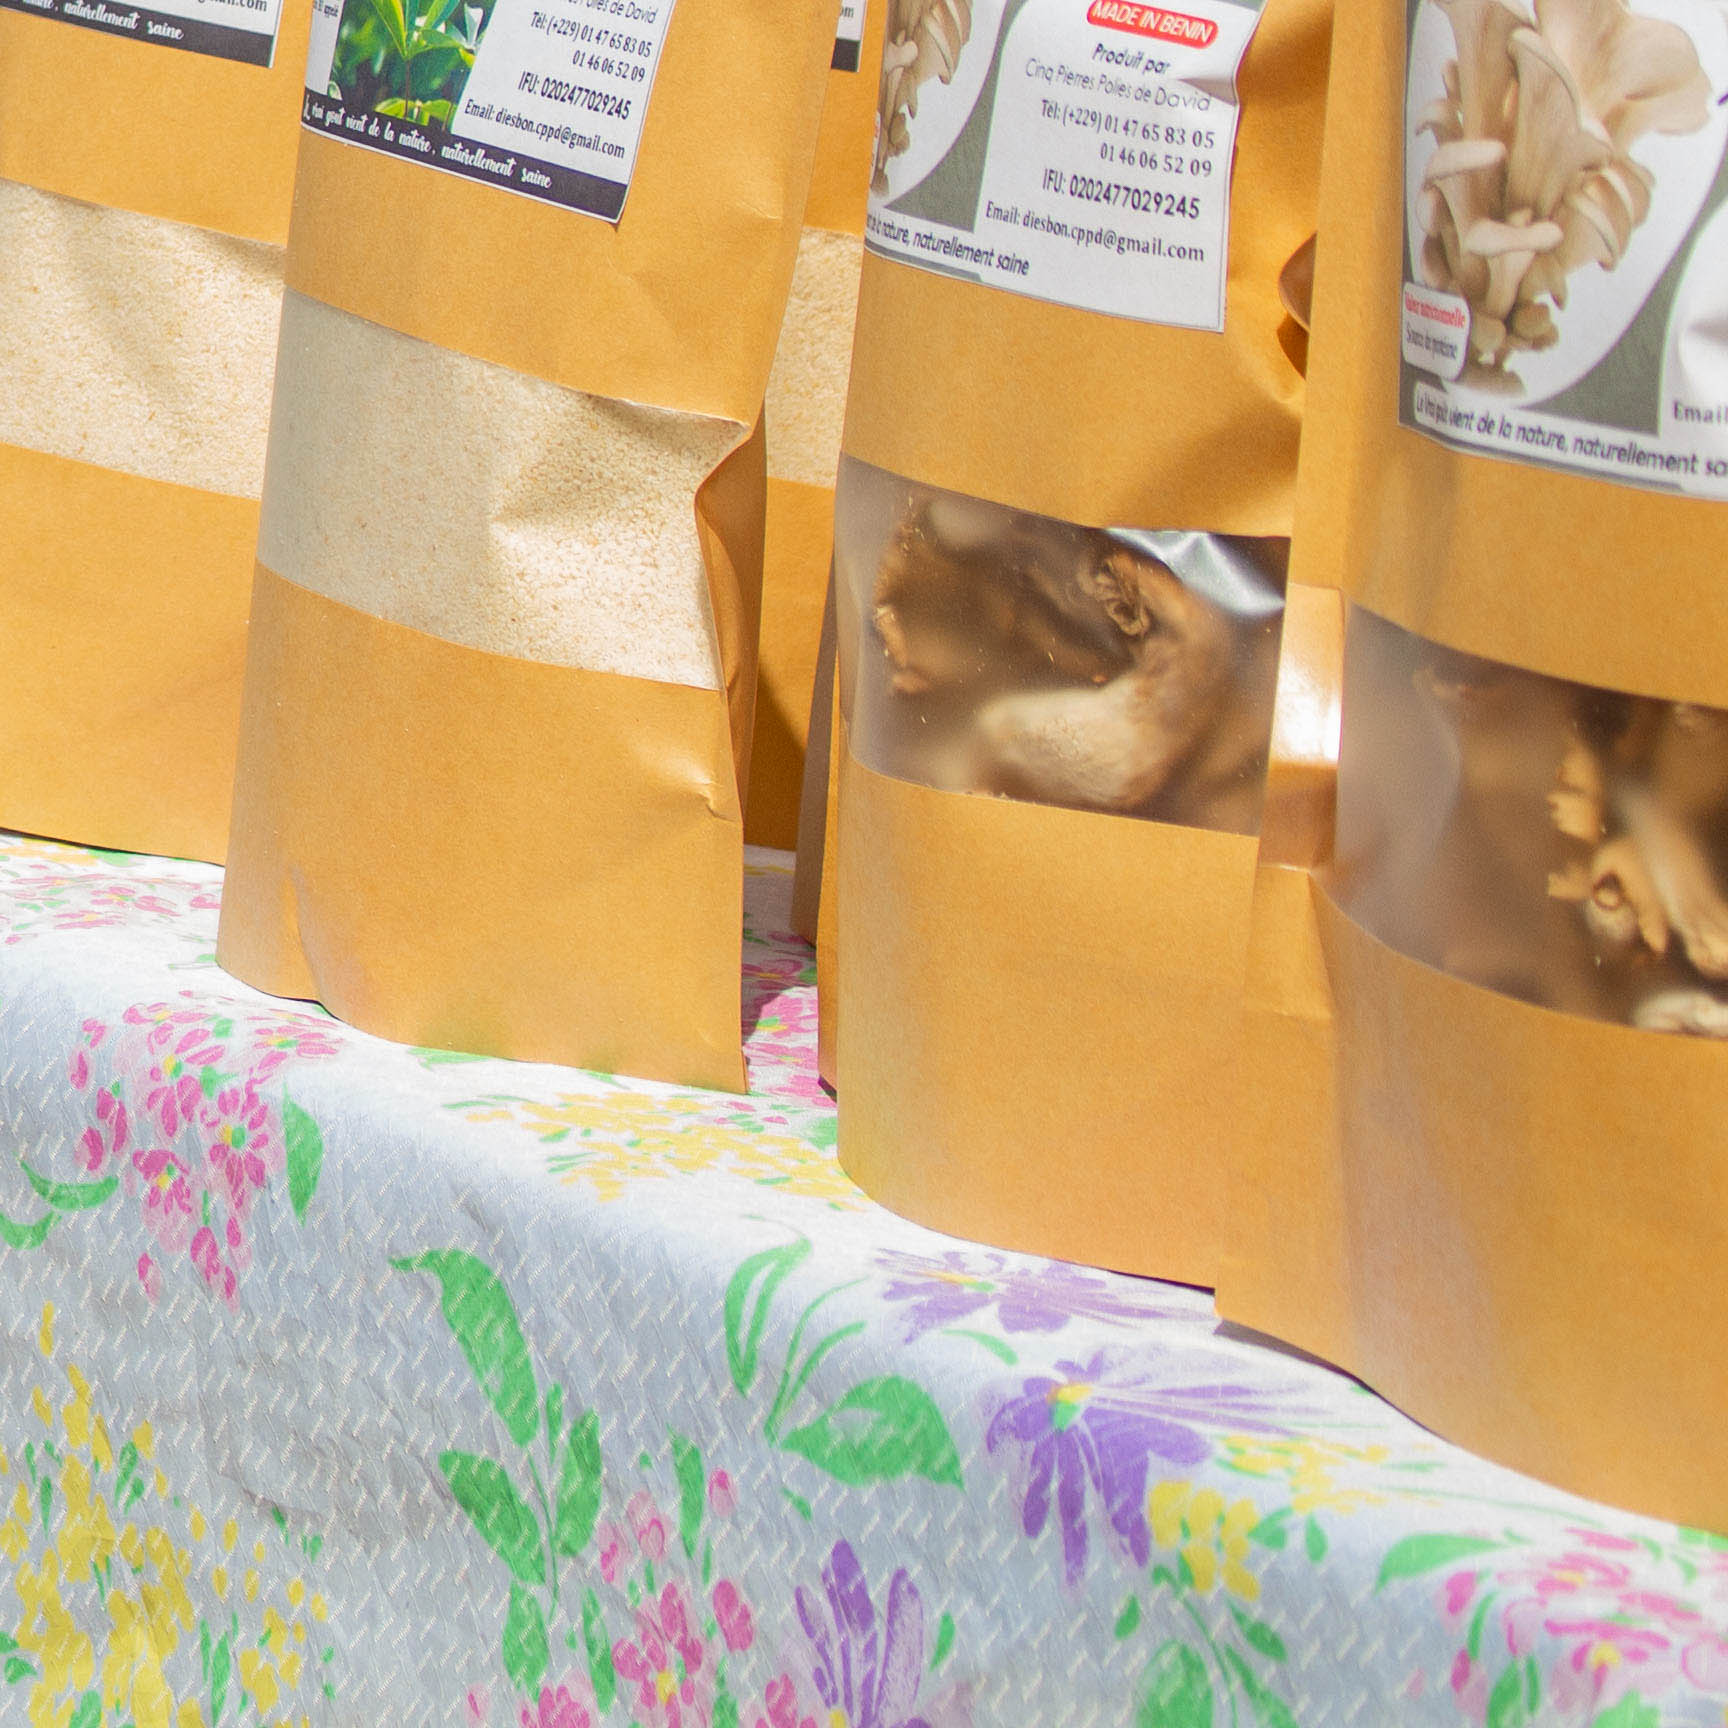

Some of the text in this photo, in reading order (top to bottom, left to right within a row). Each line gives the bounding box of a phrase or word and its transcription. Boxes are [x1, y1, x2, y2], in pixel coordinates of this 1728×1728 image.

[64, 0, 140, 30] naturellement
[147, 19, 184, 40] saine
[610, 0, 625, 15] de
[626, 1, 657, 24] David
[1092, 0, 1213, 43] MADE IN BENIN
[546, 15, 580, 42] (+229)
[581, 24, 594, 42] 01
[596, 29, 608, 45] 47
[609, 32, 622, 49] 65
[623, 36, 637, 53] 83
[638, 40, 652, 58] 05
[573, 50, 645, 83] 01 46 06 52 09
[1092, 43, 1171, 76] Produit par
[518, 71, 632, 120] IFU: 0202477029245
[1025, 57, 1211, 111] Cinq Pierres Polies de David
[465, 98, 625, 159] Email: diesbon.cppd@gmail.com
[1062, 104, 1102, 134] (+229)
[1104, 113, 1119, 133] 01
[1122, 119, 1138, 136] 47
[1142, 122, 1160, 141] 65
[1164, 126, 1185, 145] 83
[1193, 130, 1215, 149] 05
[441, 143, 516, 177] naturellement
[522, 166, 552, 189] saine
[1100, 142, 1212, 178] 01 46 06 52 09
[1043, 168, 1201, 220] IFU: 0202477029245
[913, 230, 994, 268] naturellement
[996, 252, 1030, 276] saine
[986, 200, 1206, 262] Email: diesbon.cppd@gmail.com
[1477, 408, 1495, 435] de
[1498, 415, 1511, 438] la
[1515, 421, 1568, 453] nature,
[1573, 437, 1697, 475] naturellement
